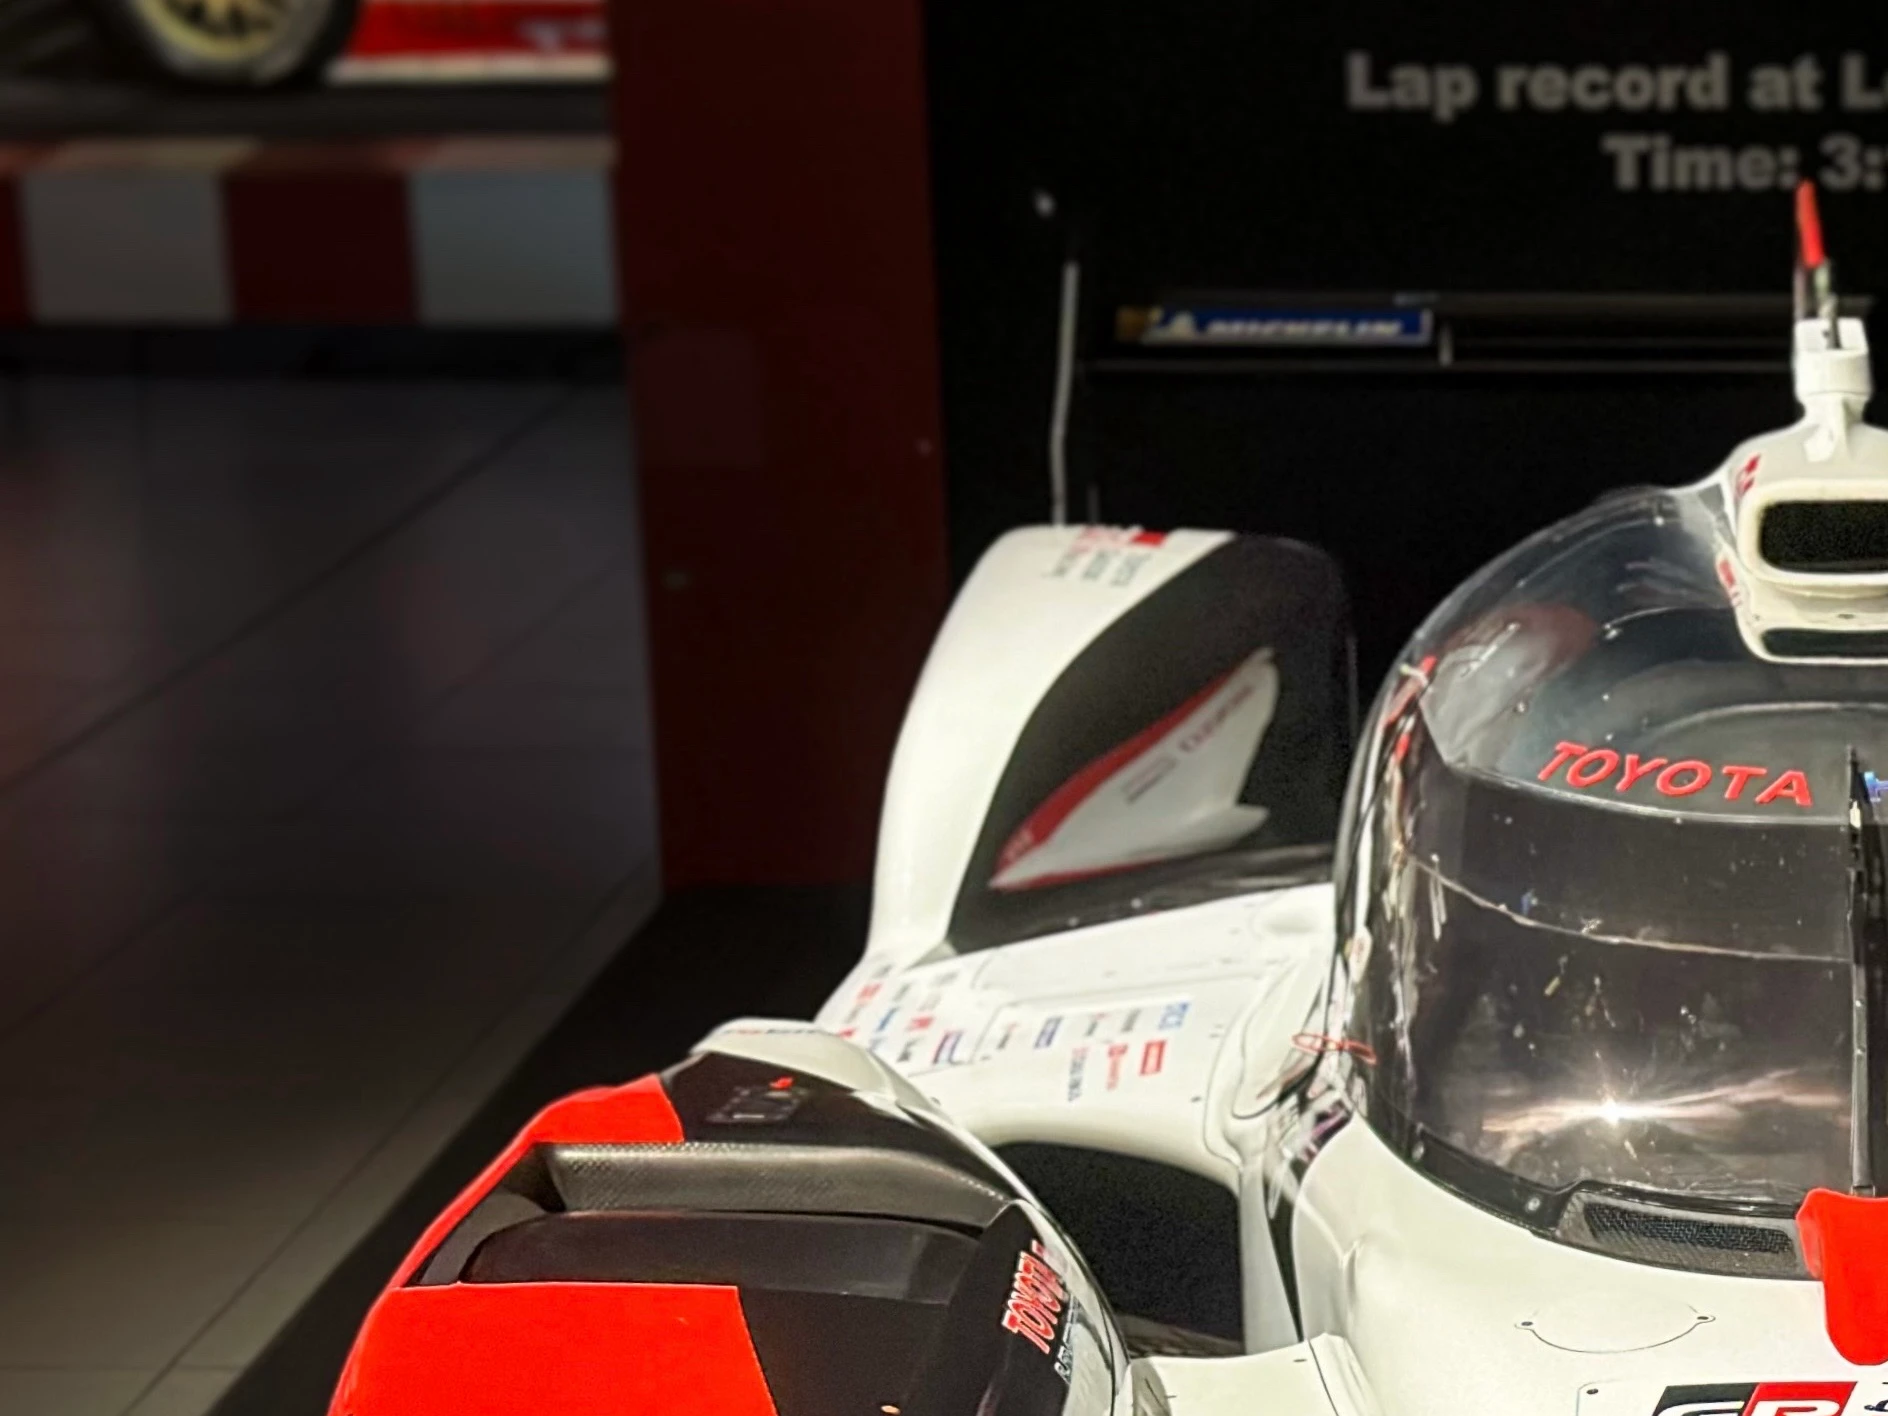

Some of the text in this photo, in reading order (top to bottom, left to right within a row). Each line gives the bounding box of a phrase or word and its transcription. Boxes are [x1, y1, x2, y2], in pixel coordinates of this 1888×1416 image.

[1346, 52, 1477, 122] Lap
[1497, 52, 1728, 112] record
[1750, 58, 1823, 112] at
[1603, 133, 1799, 191] Time:
[1537, 741, 1814, 807] TOYOTA
